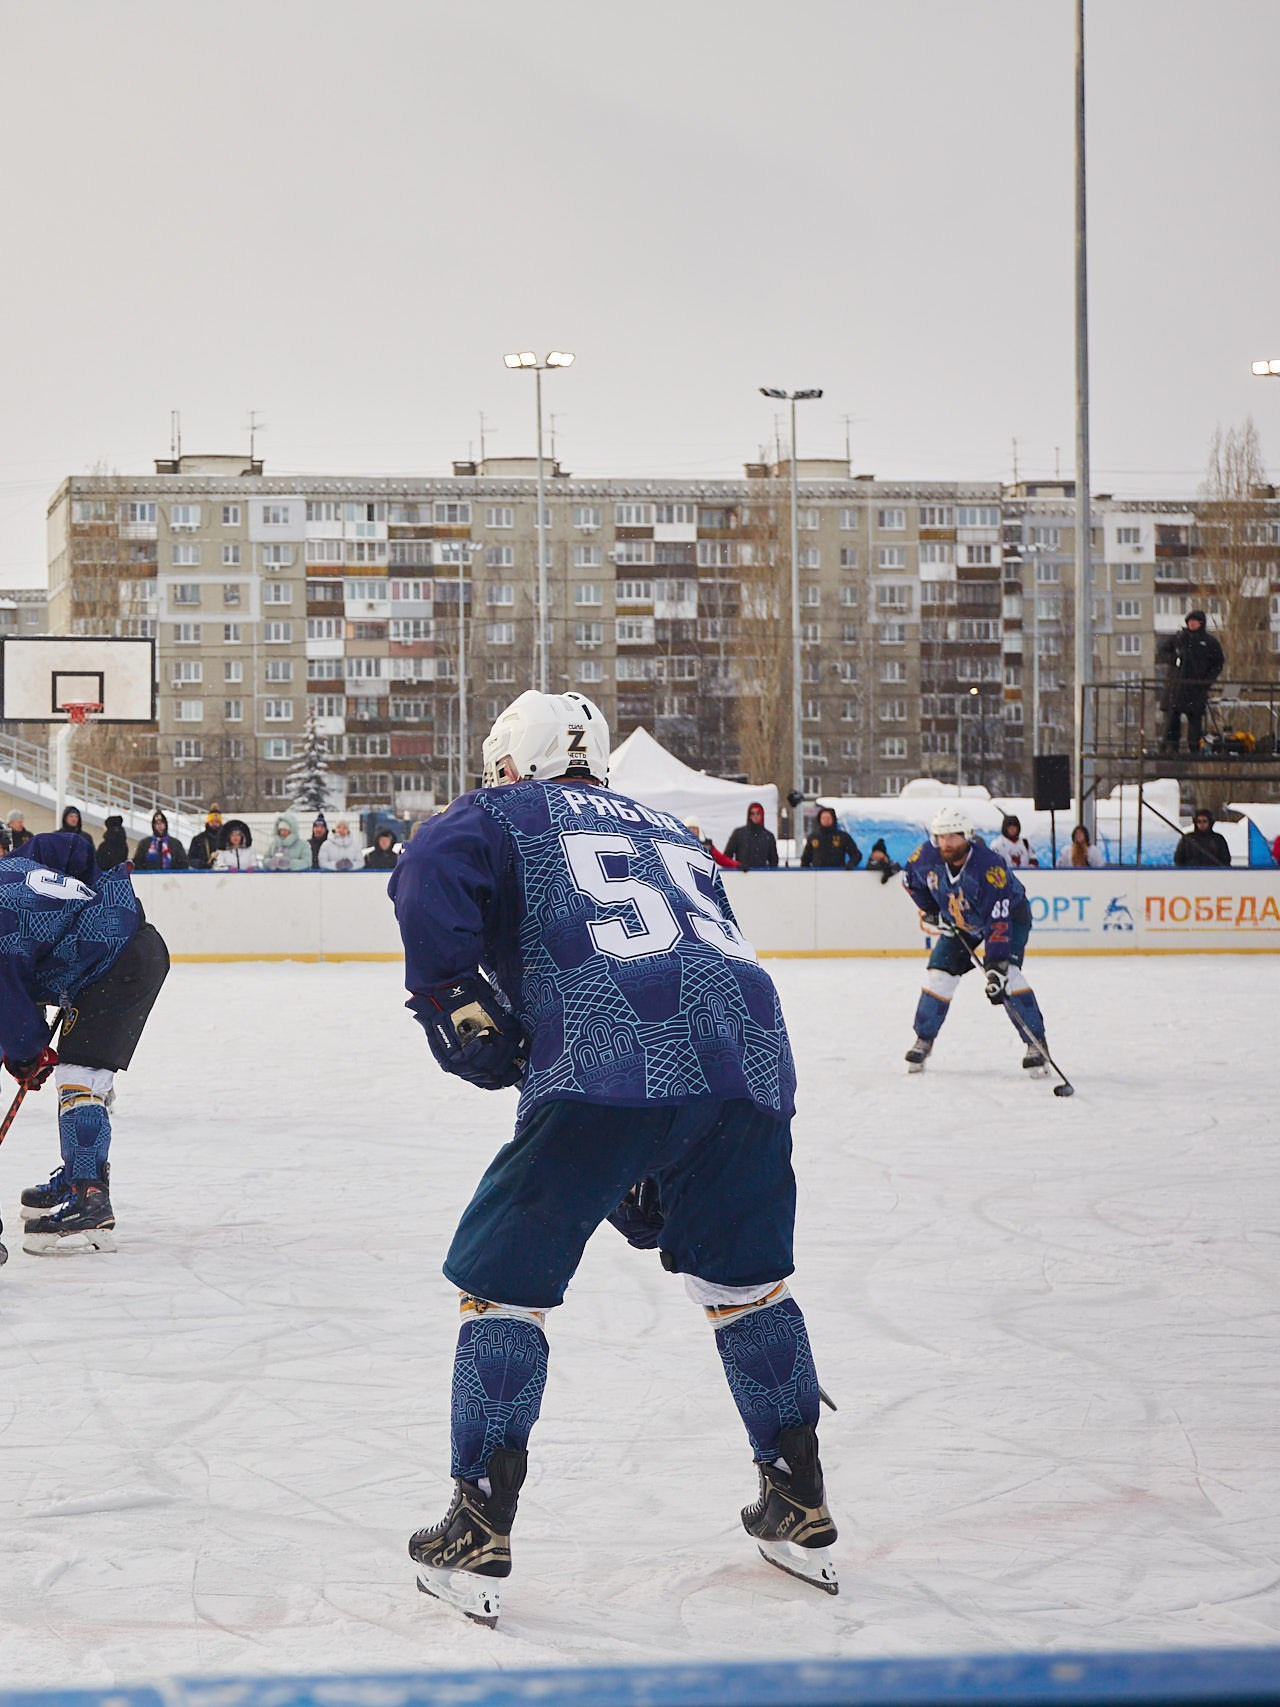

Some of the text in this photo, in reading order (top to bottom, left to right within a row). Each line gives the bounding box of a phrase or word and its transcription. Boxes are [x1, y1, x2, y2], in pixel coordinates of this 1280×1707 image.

[567, 730, 587, 752] Z
[558, 830, 760, 966] 55
[1145, 896, 1280, 927] ПОБЕДА
[776, 1511, 796, 1537] CCM
[432, 1530, 473, 1568] CCM
